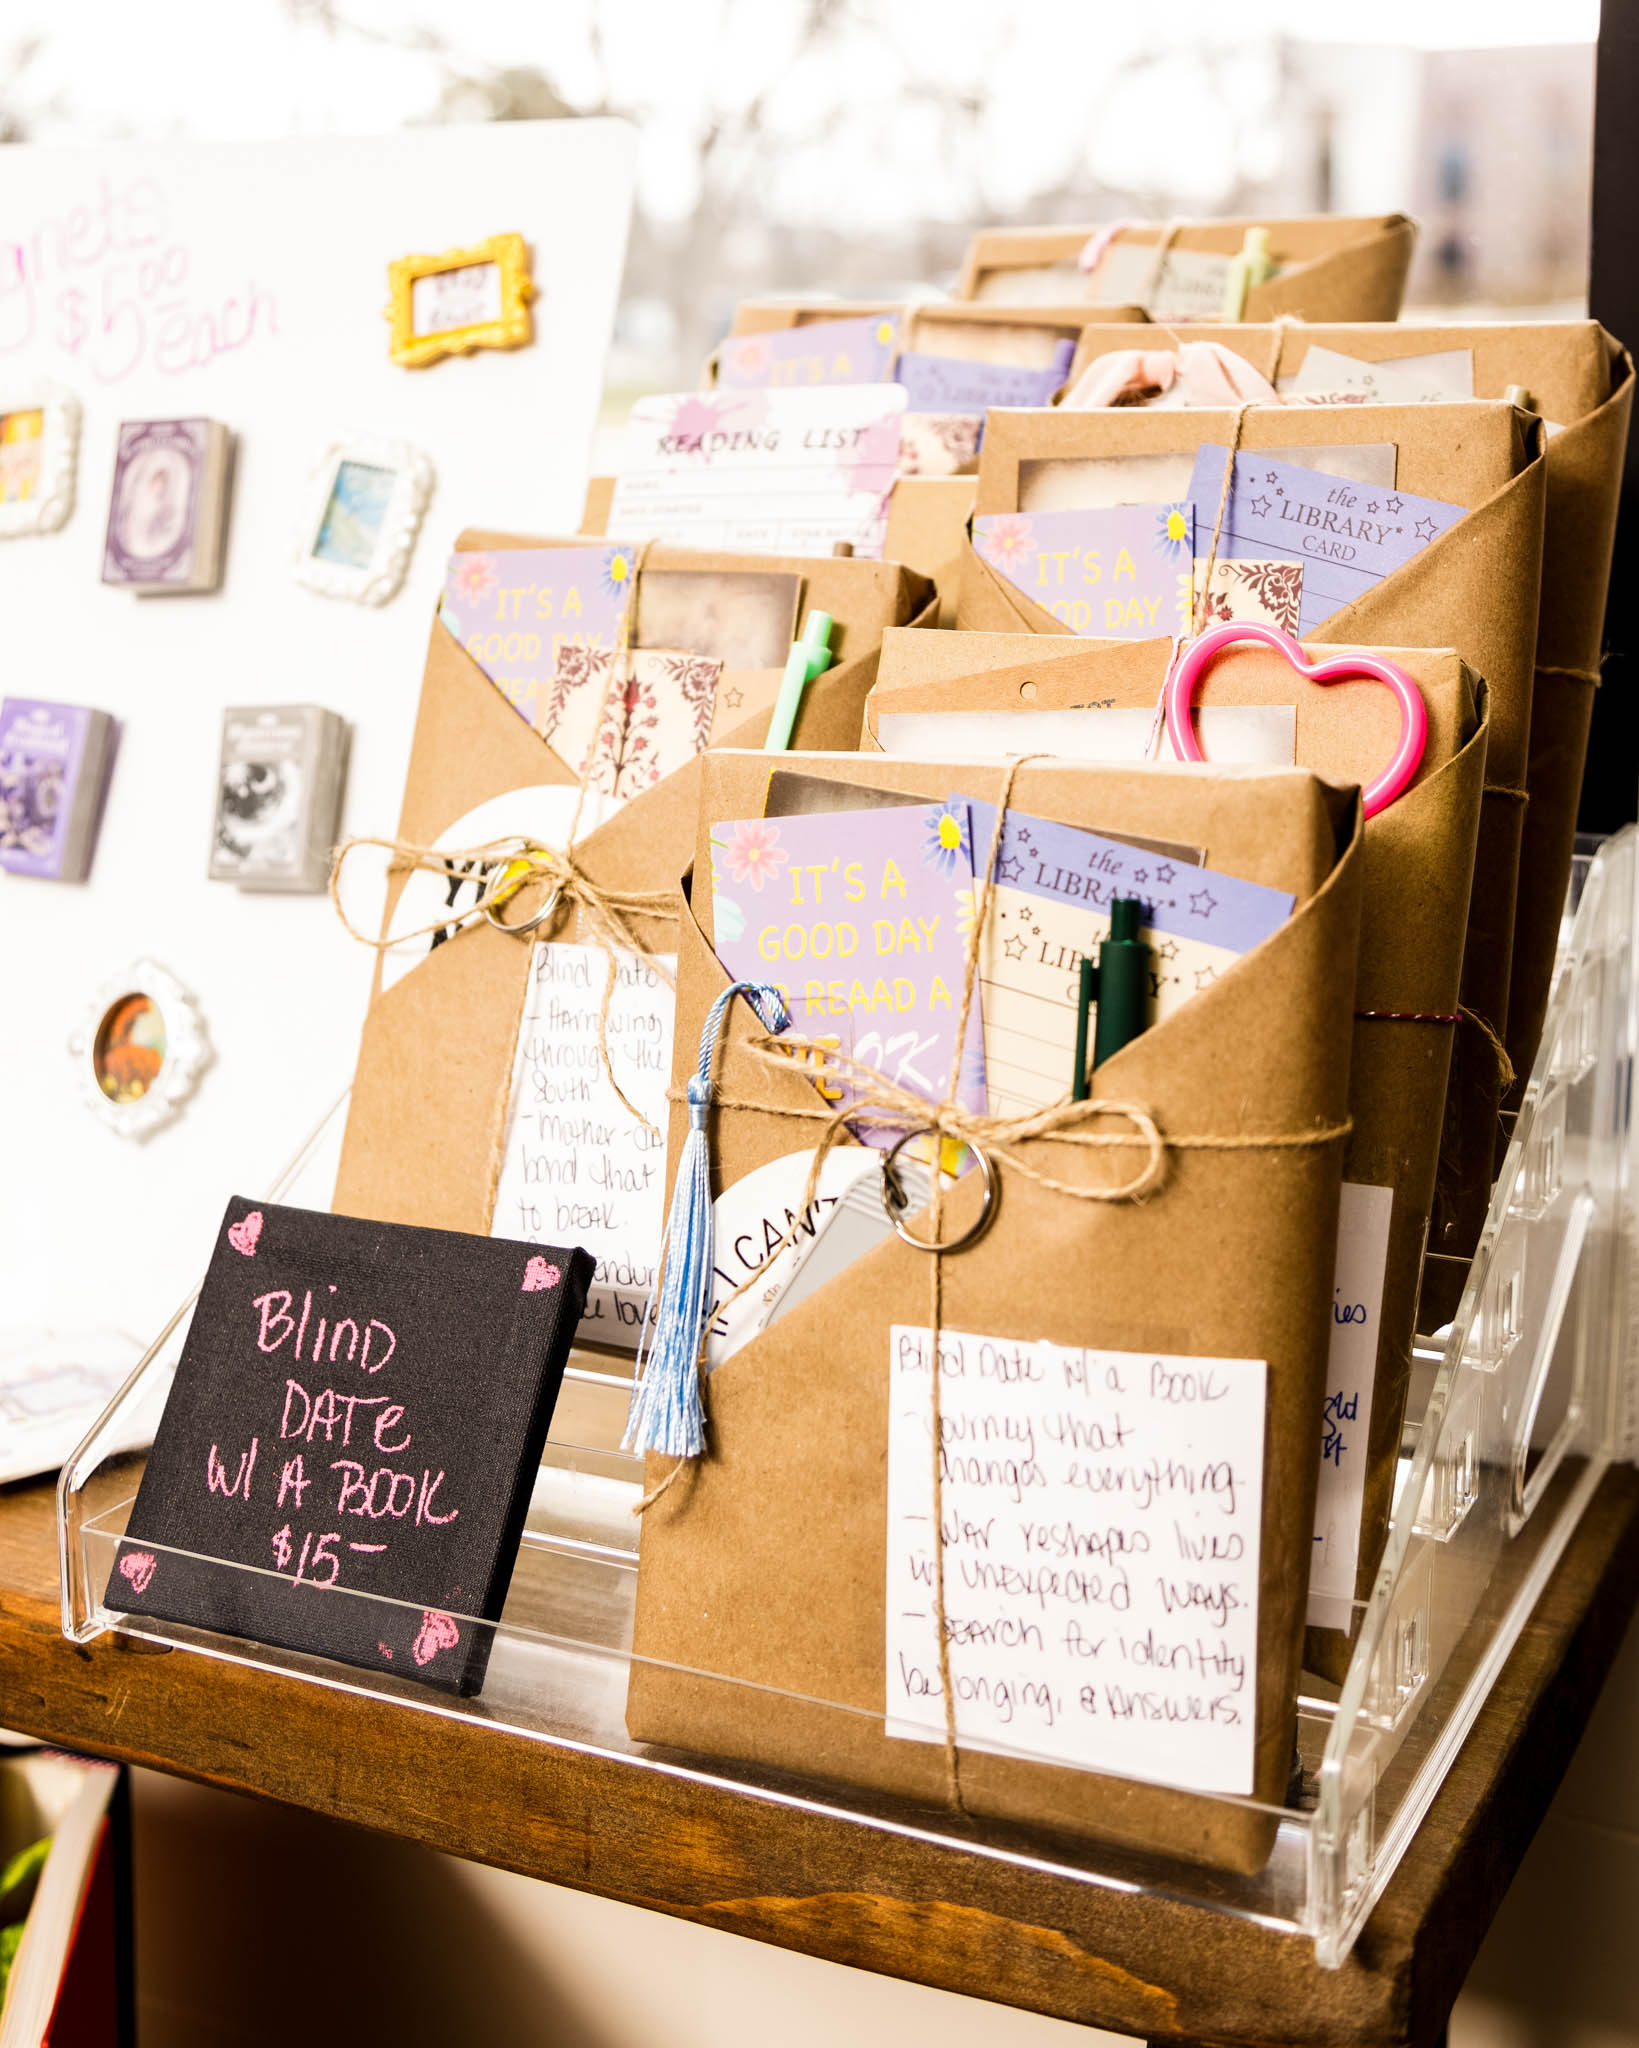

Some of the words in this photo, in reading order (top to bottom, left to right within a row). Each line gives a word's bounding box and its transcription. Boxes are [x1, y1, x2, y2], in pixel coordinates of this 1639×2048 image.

[656, 430, 781, 455] READING
[802, 426, 870, 449] LIST
[1326, 486, 1358, 509] the
[1279, 499, 1392, 546] LIBRARY
[1035, 545, 1102, 586] IT'S
[1113, 546, 1137, 583] A
[1302, 534, 1357, 562] CARD
[495, 583, 553, 621] IT'S
[561, 586, 583, 618] A
[1104, 595, 1163, 630] DAY
[465, 631, 542, 664] GOOD
[788, 856, 867, 905] IT'S
[881, 858, 907, 900] A
[1087, 848, 1123, 876] the
[1034, 861, 1165, 923] LIBRAY
[758, 921, 859, 962] GOOD
[872, 915, 941, 957] DAY
[536, 945, 591, 988] Blind
[1038, 941, 1168, 998] LIBY
[804, 977, 917, 1017] REAAD
[928, 974, 953, 1012] A
[622, 1037, 665, 1072] the
[531, 1069, 592, 1104] South
[521, 1143, 578, 1185] bond
[589, 1153, 657, 1193] that
[517, 1196, 542, 1232] to
[979, 1343, 1045, 1384] Date
[1105, 1364, 1126, 1393] a
[924, 1413, 1035, 1465] ourney
[1042, 1411, 1135, 1453] that
[276, 1454, 311, 1509] A
[330, 1459, 459, 1527] BOOK
[936, 1446, 1047, 1504] hanges
[1173, 1510, 1244, 1561] lives
[1061, 1618, 1106, 1658] for
[899, 1650, 1062, 1727] beonging,
